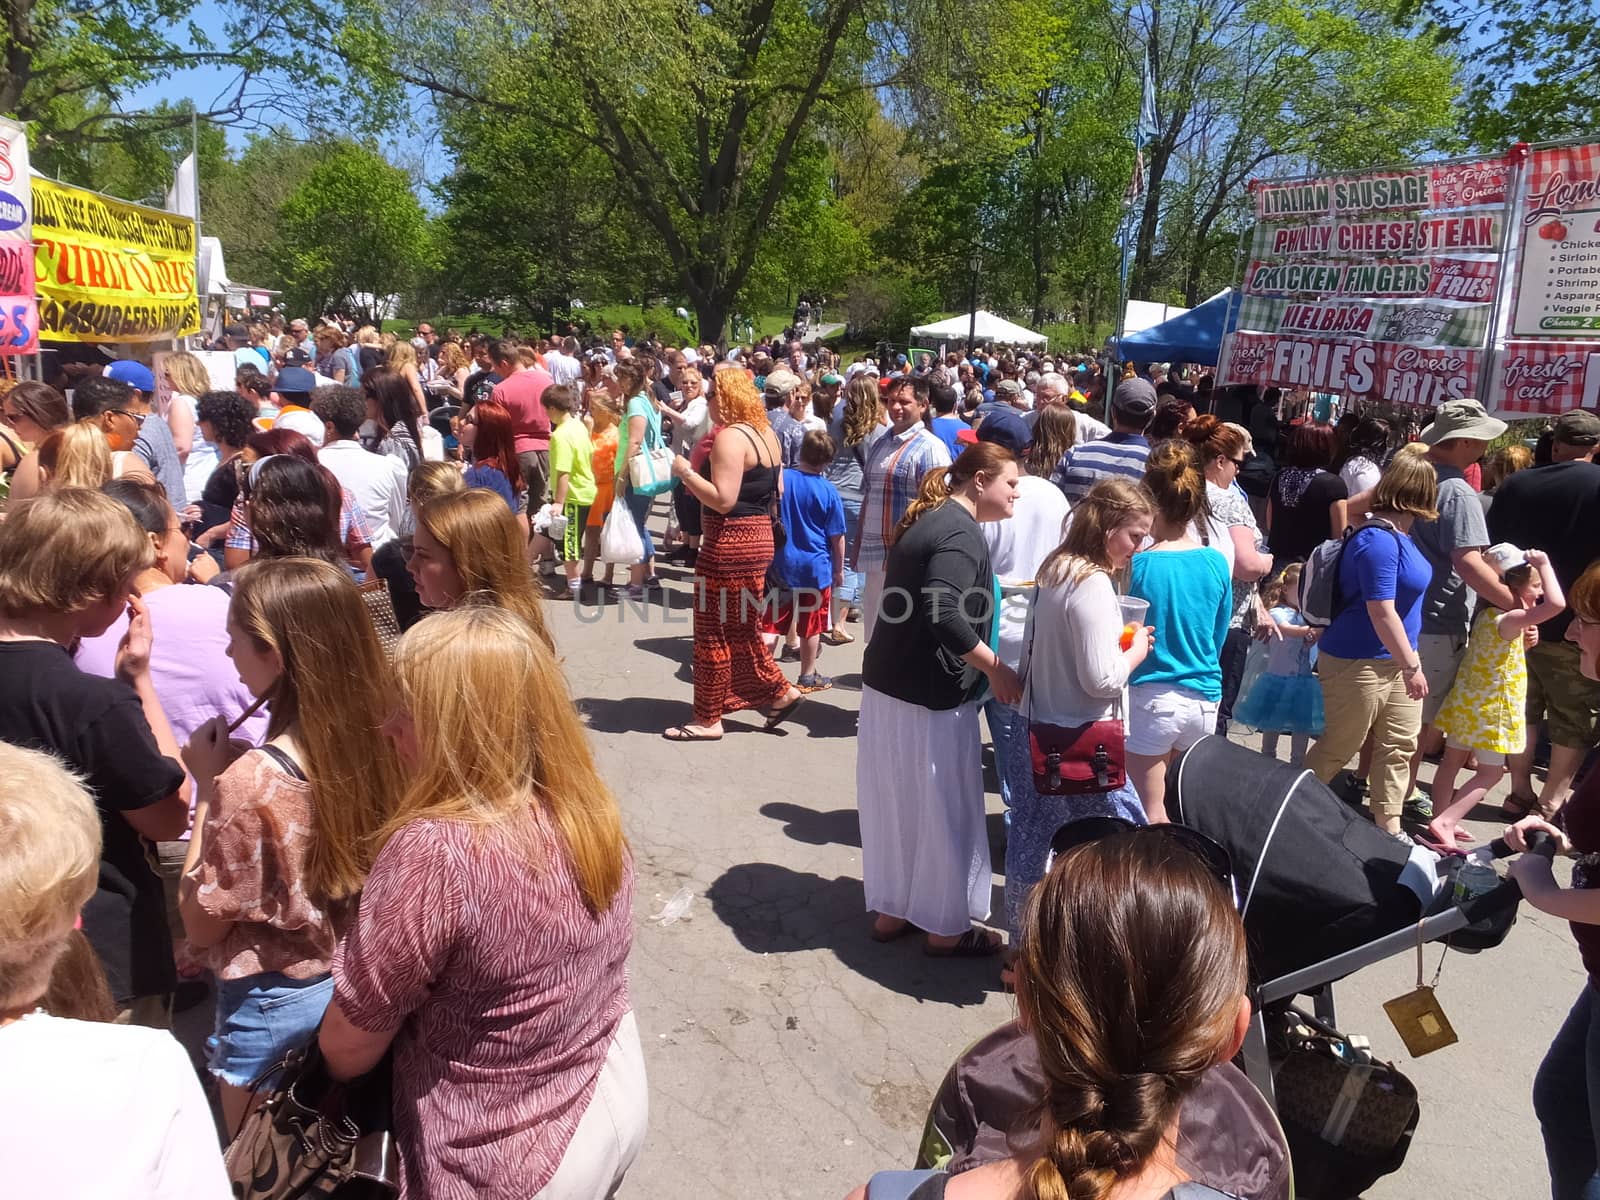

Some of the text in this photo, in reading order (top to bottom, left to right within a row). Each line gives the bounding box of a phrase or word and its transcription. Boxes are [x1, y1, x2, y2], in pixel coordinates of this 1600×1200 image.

[1432, 172, 1457, 186] with
[1263, 173, 1430, 215] ITALIAN SAUSAGE
[1445, 190, 1456, 203] &
[1337, 219, 1415, 253] CHEESE
[1416, 217, 1494, 250] STEAK
[1559, 253, 1597, 262] Sirloin
[1251, 263, 1431, 294] CHICKEN FINGERS
[1435, 275, 1492, 298] FRIES
[1556, 279, 1598, 288] Shrimp
[1280, 304, 1375, 334] KIELBASA
[1552, 304, 1591, 314] Veggie
[1581, 317, 1593, 328] 2
[1271, 340, 1376, 393] FRIES
[1518, 379, 1568, 399] cut
